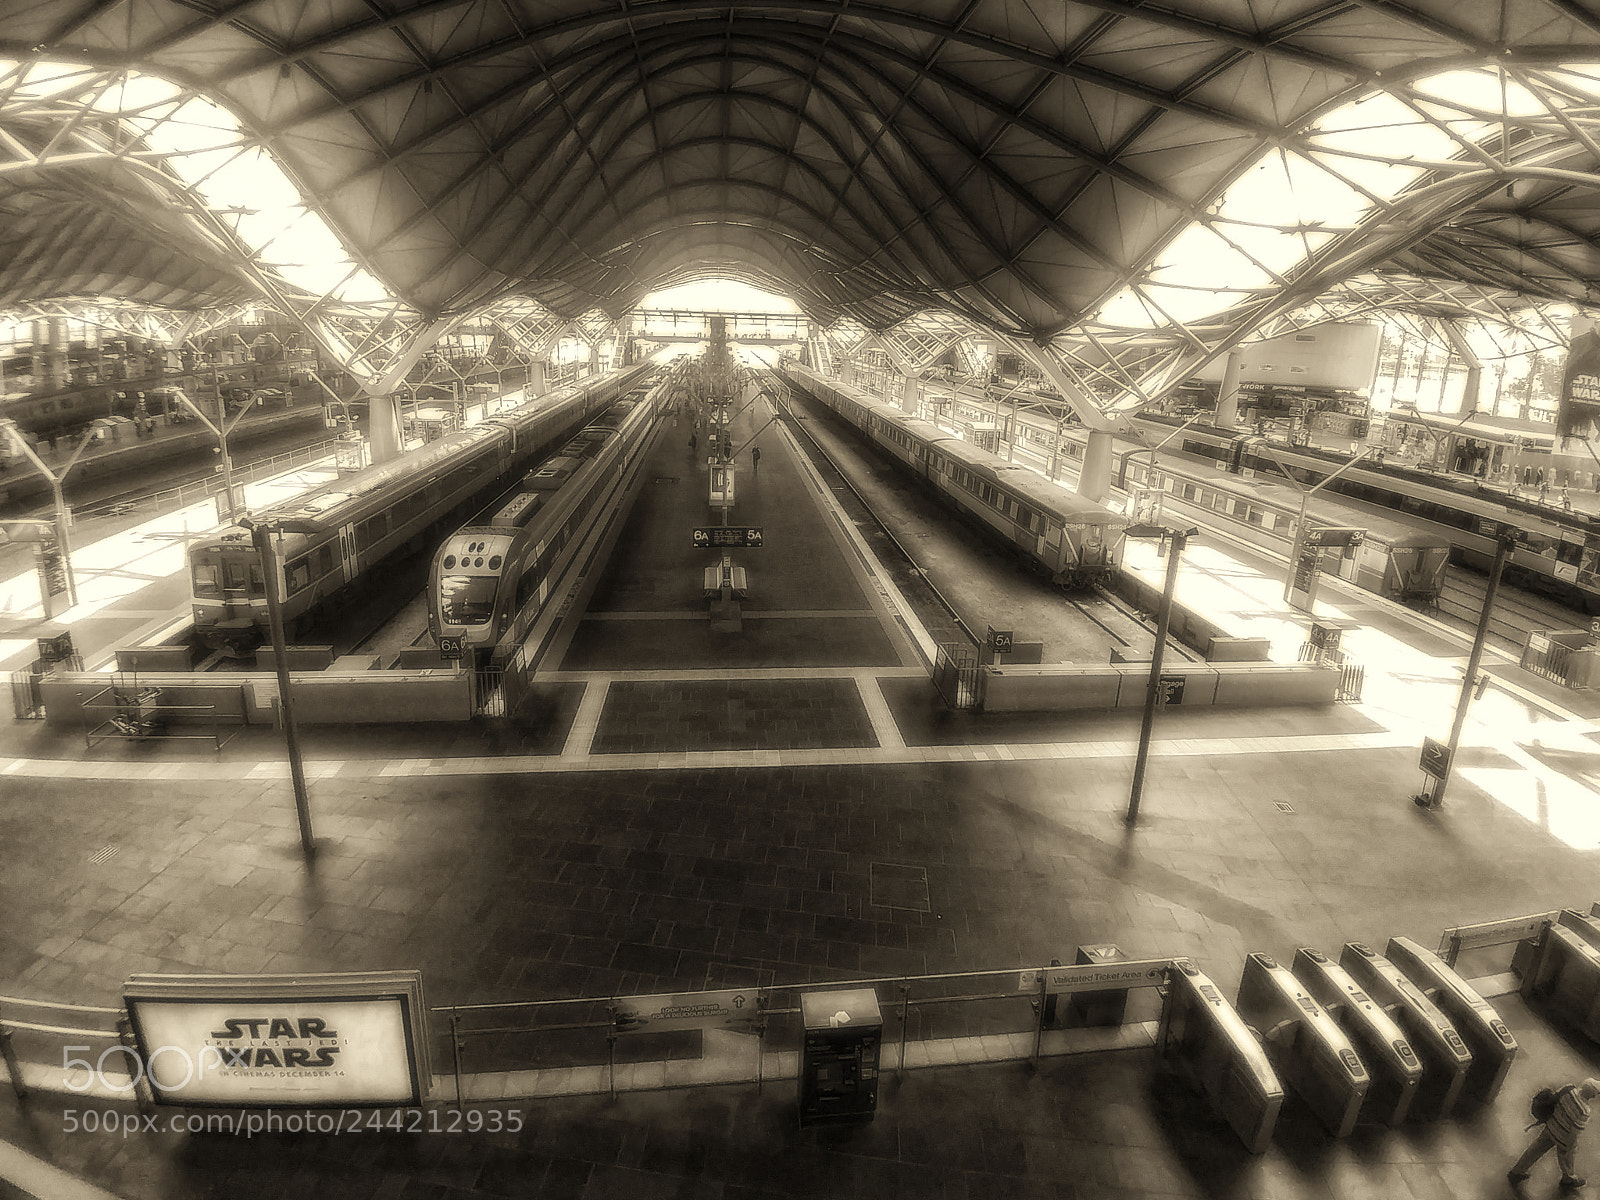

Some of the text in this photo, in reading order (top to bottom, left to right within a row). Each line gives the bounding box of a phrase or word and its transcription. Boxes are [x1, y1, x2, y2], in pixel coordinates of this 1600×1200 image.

[1573, 374, 1600, 387] STA
[693, 530, 709, 541] 6A
[747, 529, 762, 540] 5A
[1309, 531, 1321, 540] 4A
[1351, 531, 1364, 540] 3A
[1591, 621, 1600, 633] 3
[995, 634, 1011, 646] 5A
[1326, 632, 1339, 643] 4A
[441, 639, 460, 651] 6A
[1053, 970, 1142, 985] Validated Ticket Area
[210, 1018, 338, 1039] STAR
[217, 1047, 341, 1068] WARS
